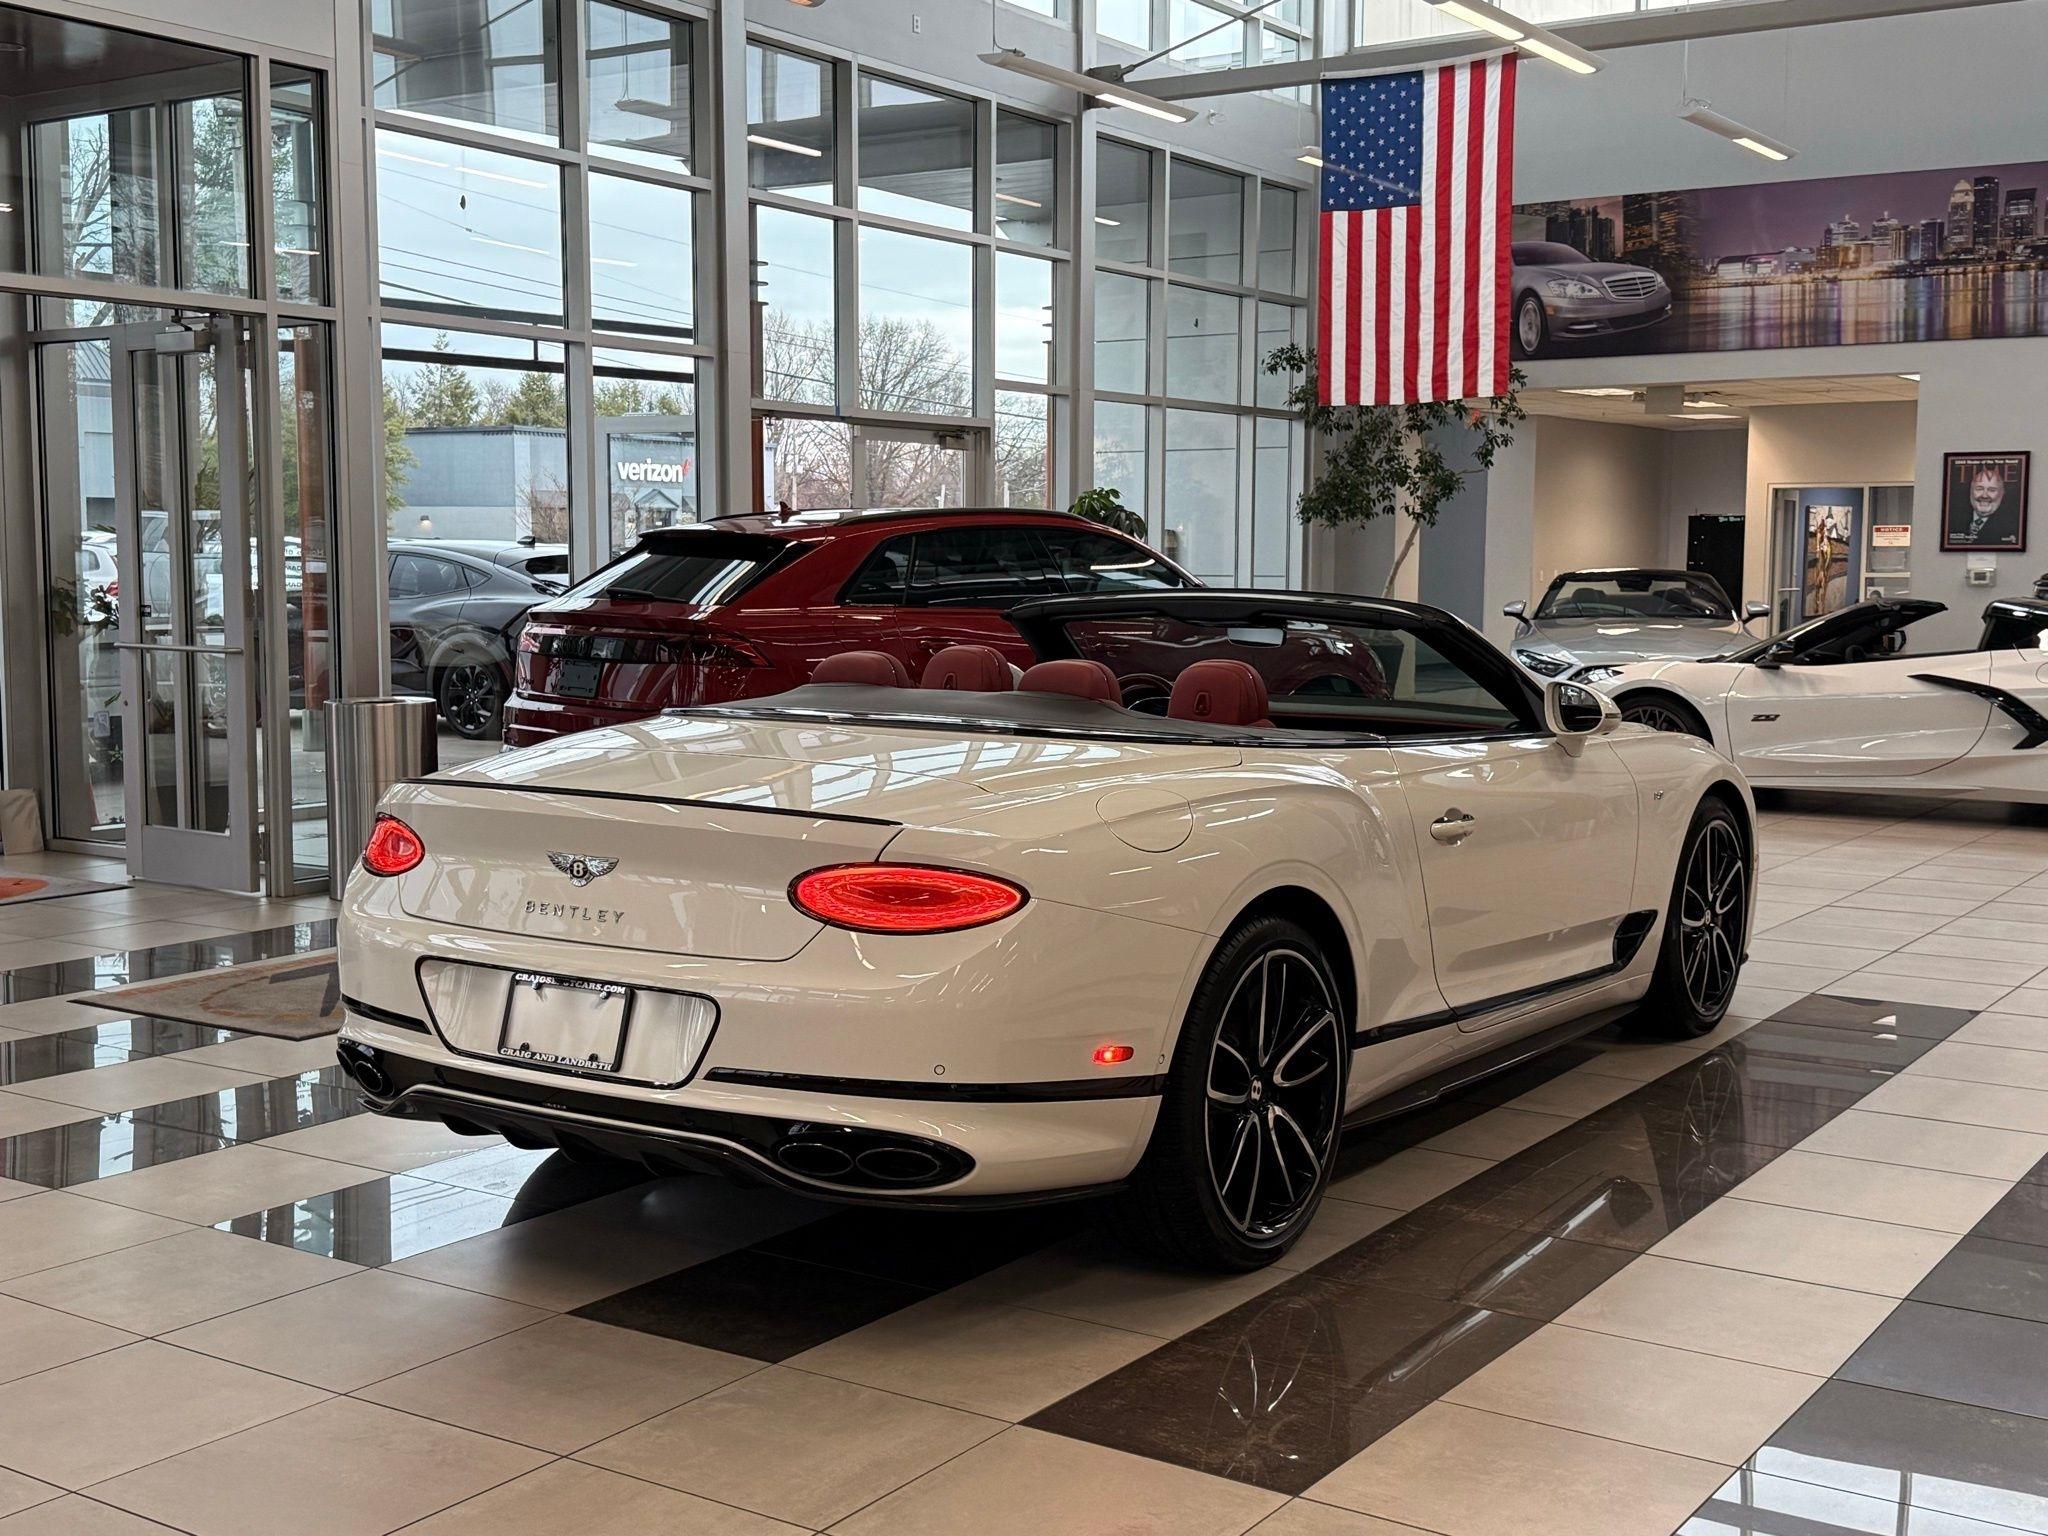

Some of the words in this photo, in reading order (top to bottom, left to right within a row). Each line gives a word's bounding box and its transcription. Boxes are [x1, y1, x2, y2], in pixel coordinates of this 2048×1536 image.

[617, 457, 683, 483] verizon
[524, 900, 625, 924] BENTLEY
[515, 973, 626, 995] CRAIGSTCARS.COM
[500, 1047, 532, 1059] CRAIG
[534, 1052, 556, 1063] AND
[557, 1056, 613, 1072] LANDRETH
